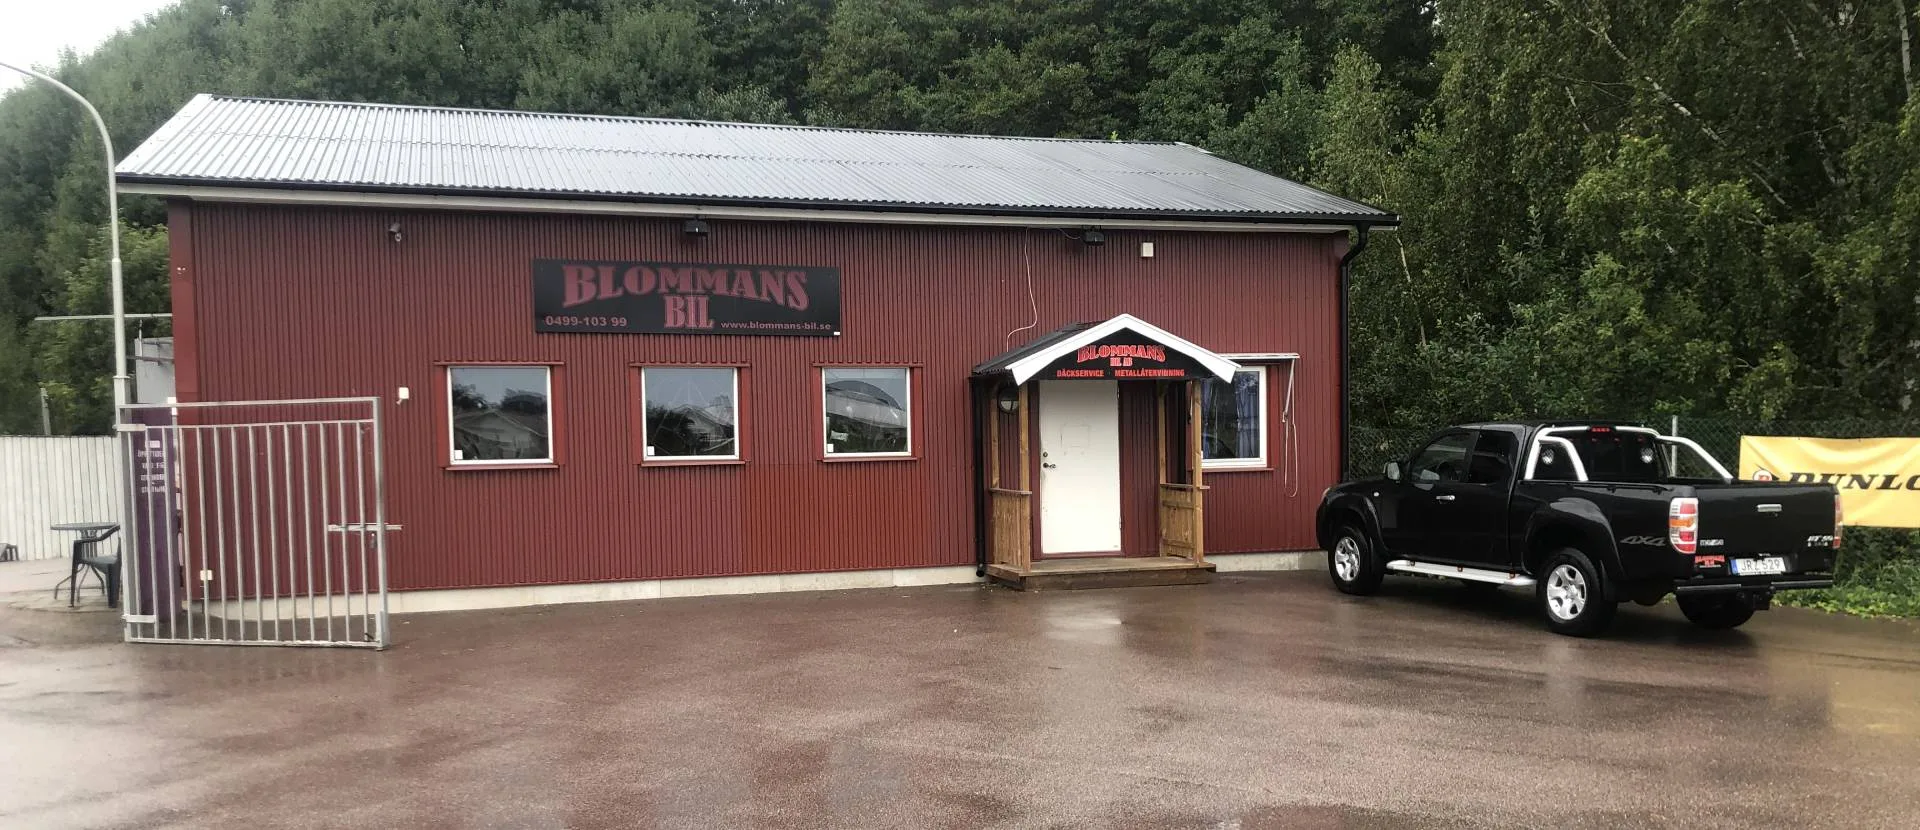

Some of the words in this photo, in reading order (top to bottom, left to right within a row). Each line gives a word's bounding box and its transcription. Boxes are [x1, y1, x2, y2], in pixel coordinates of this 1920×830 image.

[561, 264, 809, 312] BLOMMANS
[663, 294, 716, 329] BIL
[545, 315, 607, 327] 0499-103
[611, 316, 628, 327] 99
[720, 320, 832, 331] www.blommans-bil.se
[1077, 344, 1166, 363] BLOMMANS
[1056, 368, 1105, 377] DÄCKSERVICE
